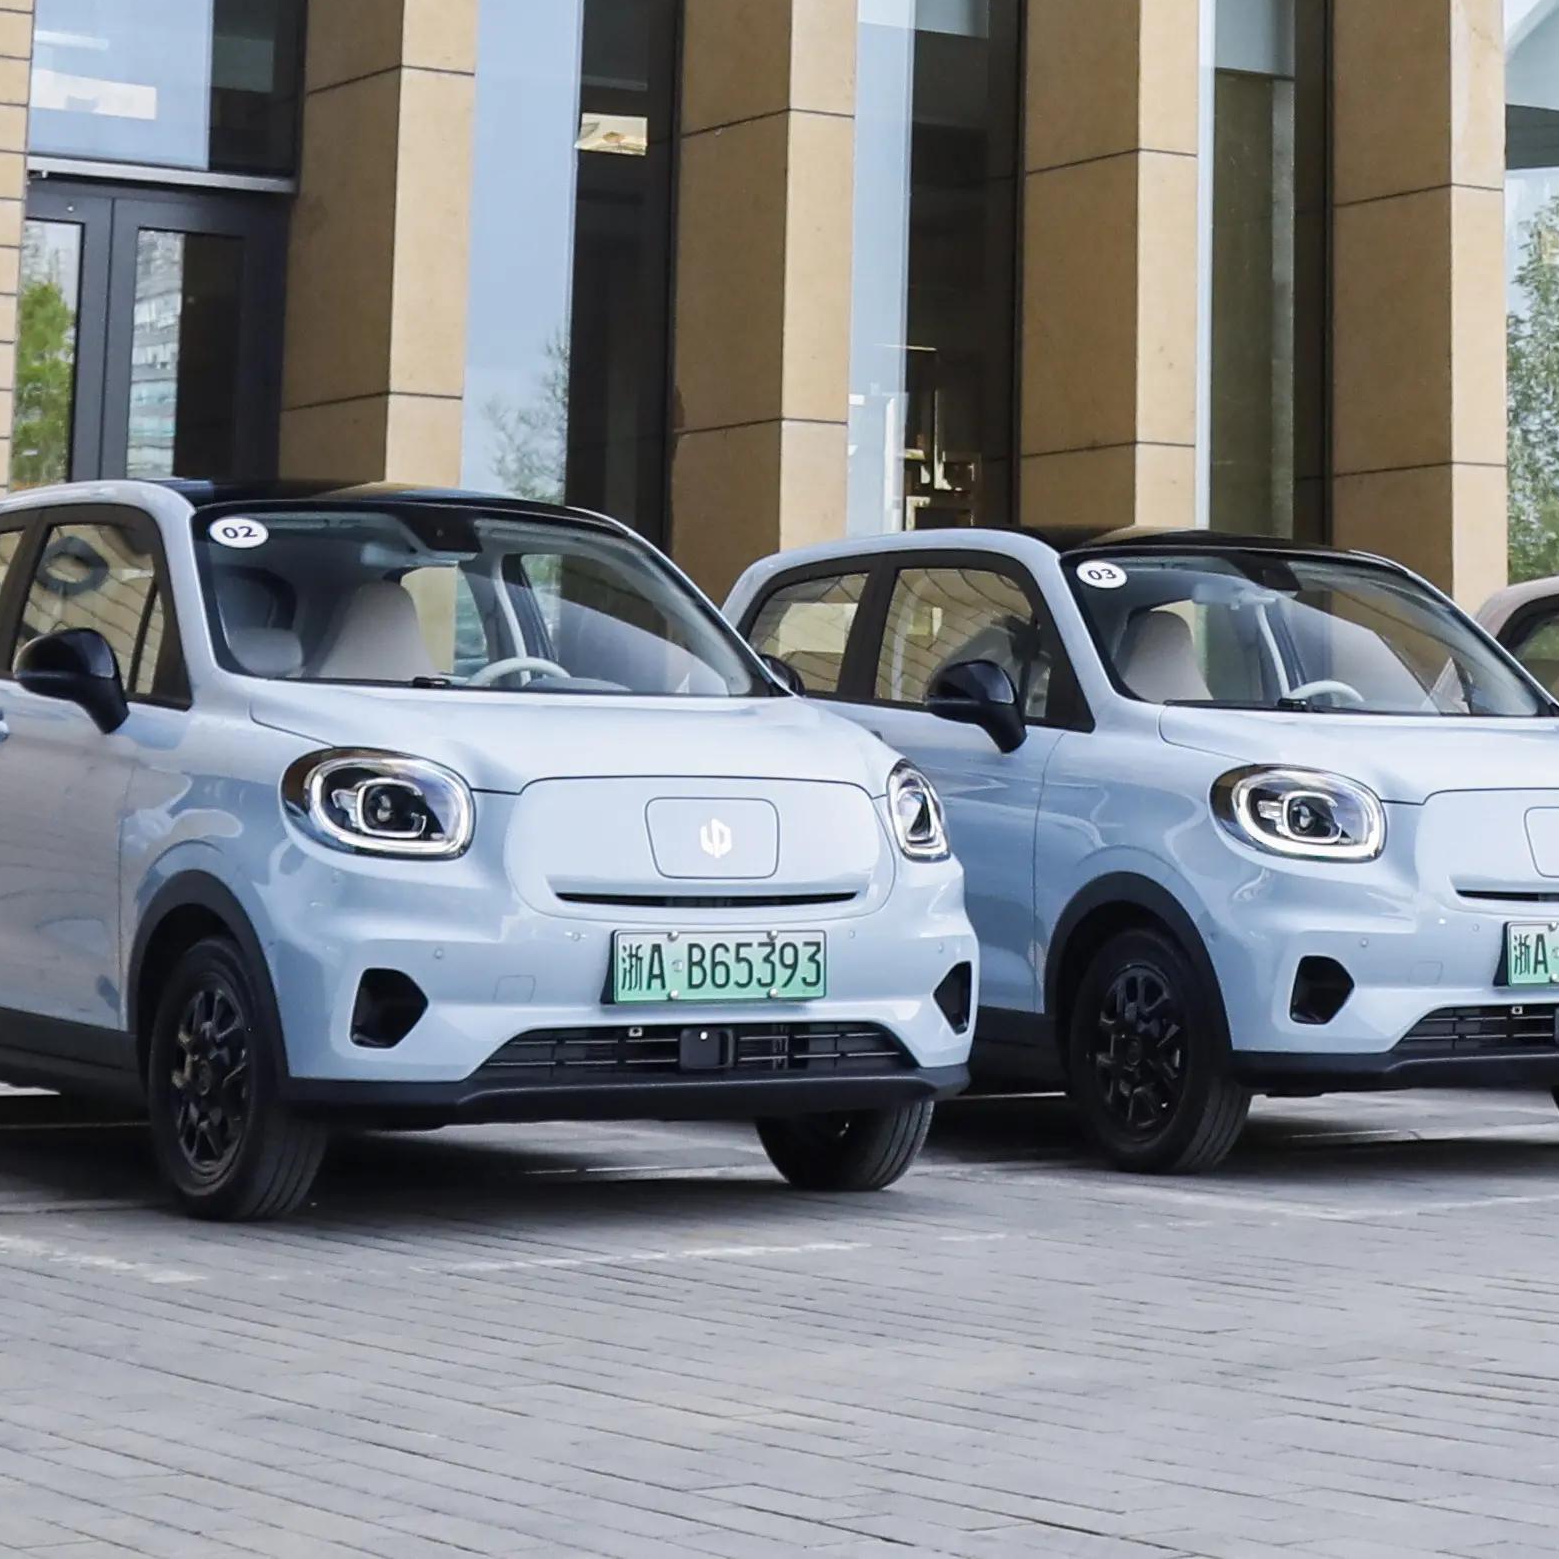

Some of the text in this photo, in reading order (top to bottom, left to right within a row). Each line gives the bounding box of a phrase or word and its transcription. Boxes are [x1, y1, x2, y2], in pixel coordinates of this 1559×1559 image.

[222, 525, 258, 539] 02
[1087, 568, 1117, 580] 03
[687, 941, 822, 990] B65393
